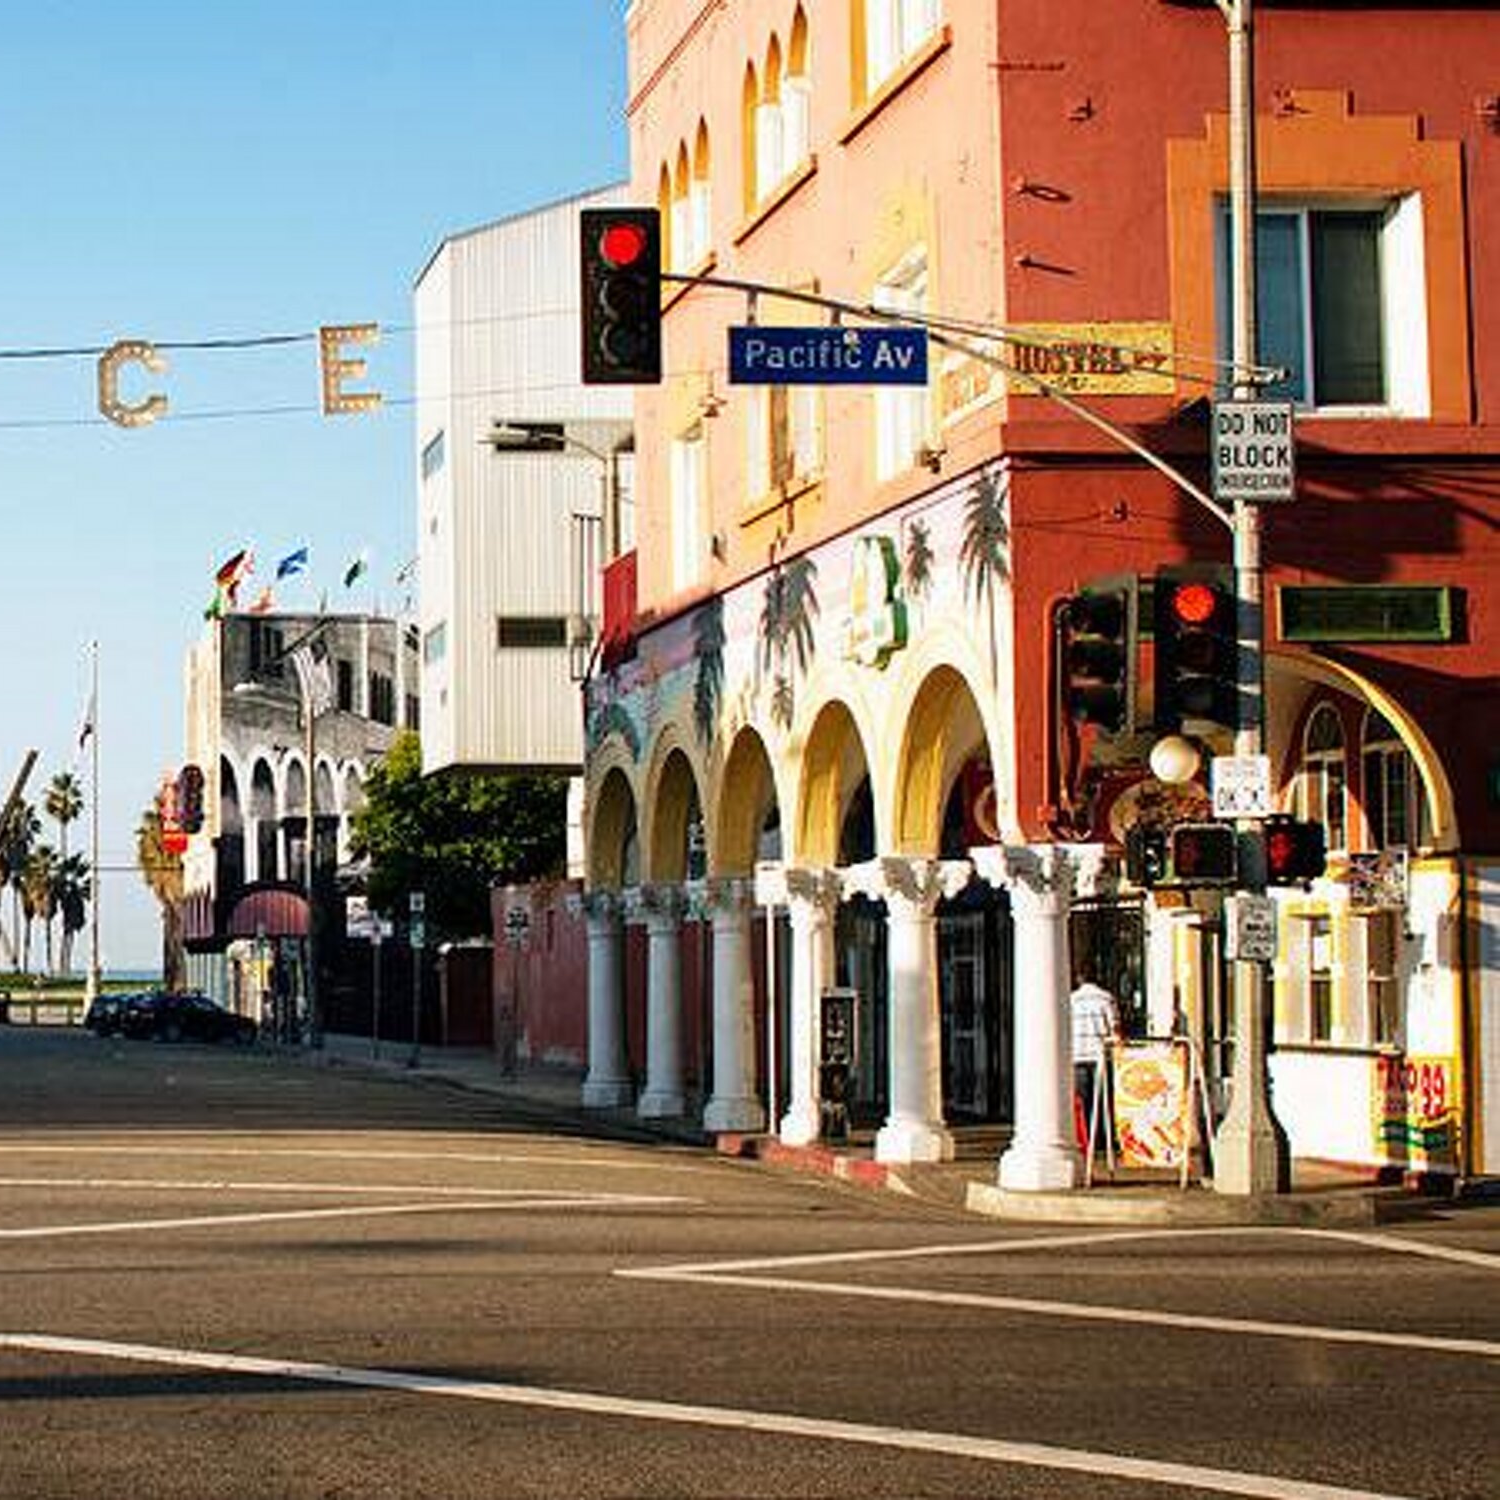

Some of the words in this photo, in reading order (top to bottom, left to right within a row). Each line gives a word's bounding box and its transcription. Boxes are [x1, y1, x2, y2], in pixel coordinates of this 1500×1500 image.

[745, 338, 863, 369] Pacific
[873, 339, 915, 369] Av
[1012, 342, 1126, 375] HOSTEL
[1218, 413, 1245, 435] DO
[1252, 413, 1289, 435] NOT
[1219, 445, 1289, 468] BLOCK
